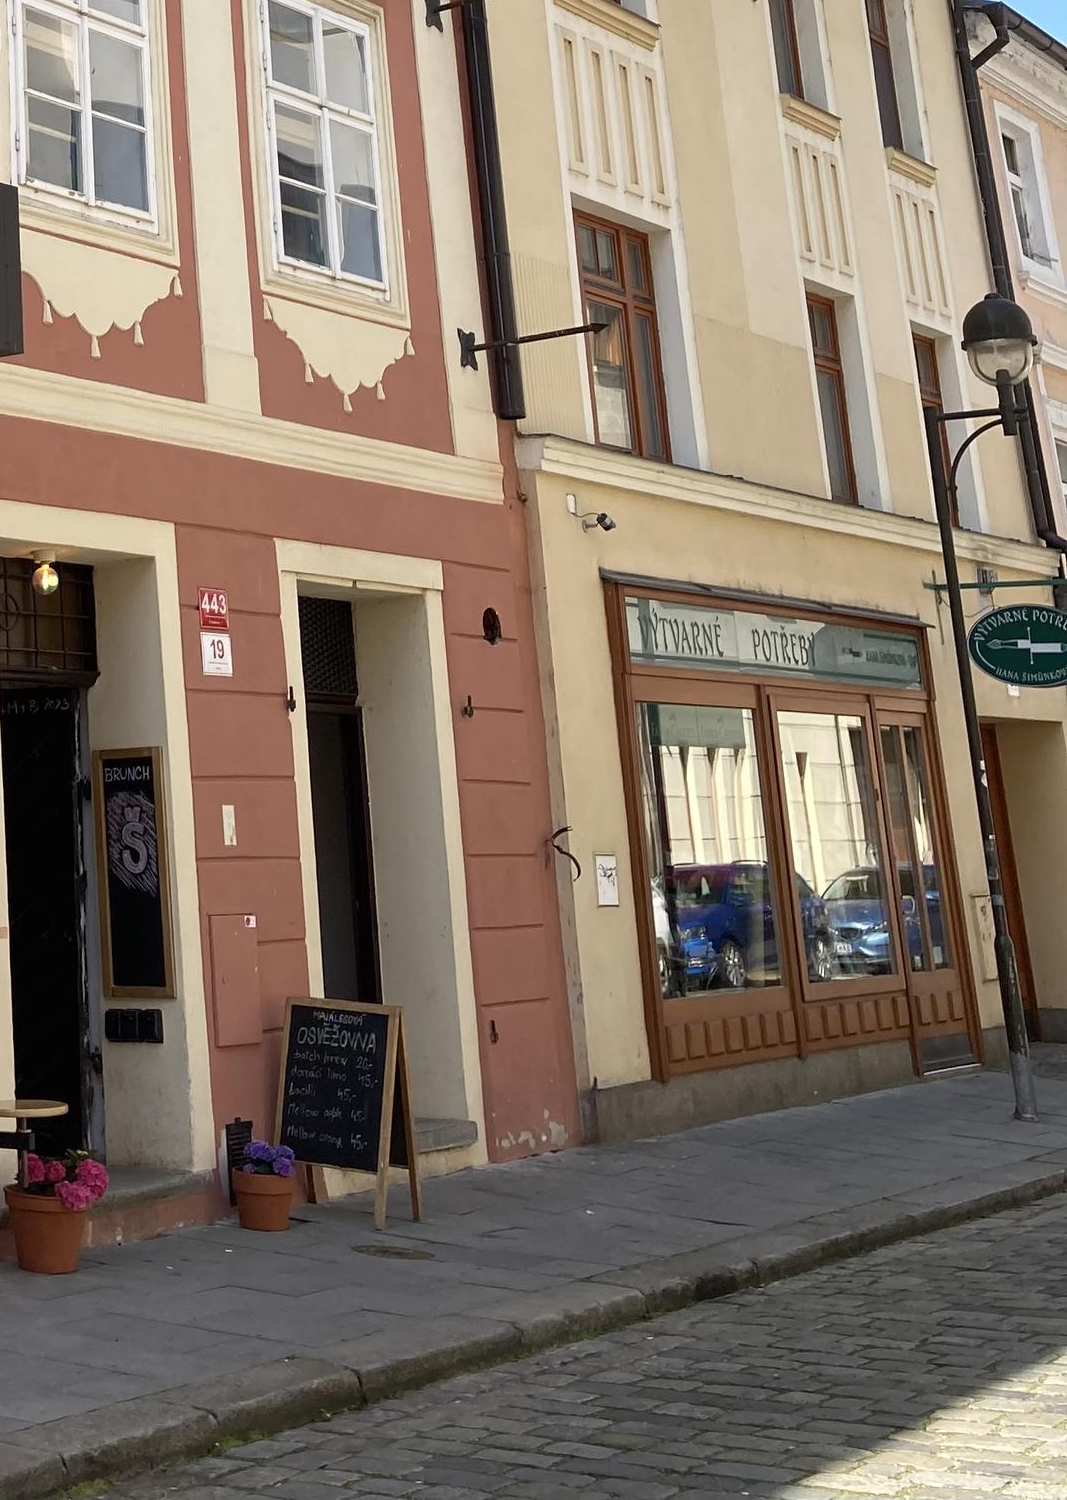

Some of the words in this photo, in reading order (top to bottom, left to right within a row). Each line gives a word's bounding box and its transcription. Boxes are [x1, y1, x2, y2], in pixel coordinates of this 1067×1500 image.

[201, 592, 227, 614] 443
[637, 608, 724, 657] VÝTVARNÉ
[751, 625, 816, 668] POTŘEBY
[210, 639, 225, 659] 19
[995, 667, 1020, 681] HANA
[104, 765, 150, 782] BRUNCH
[297, 1022, 376, 1054] OSVĚŽOVNA
